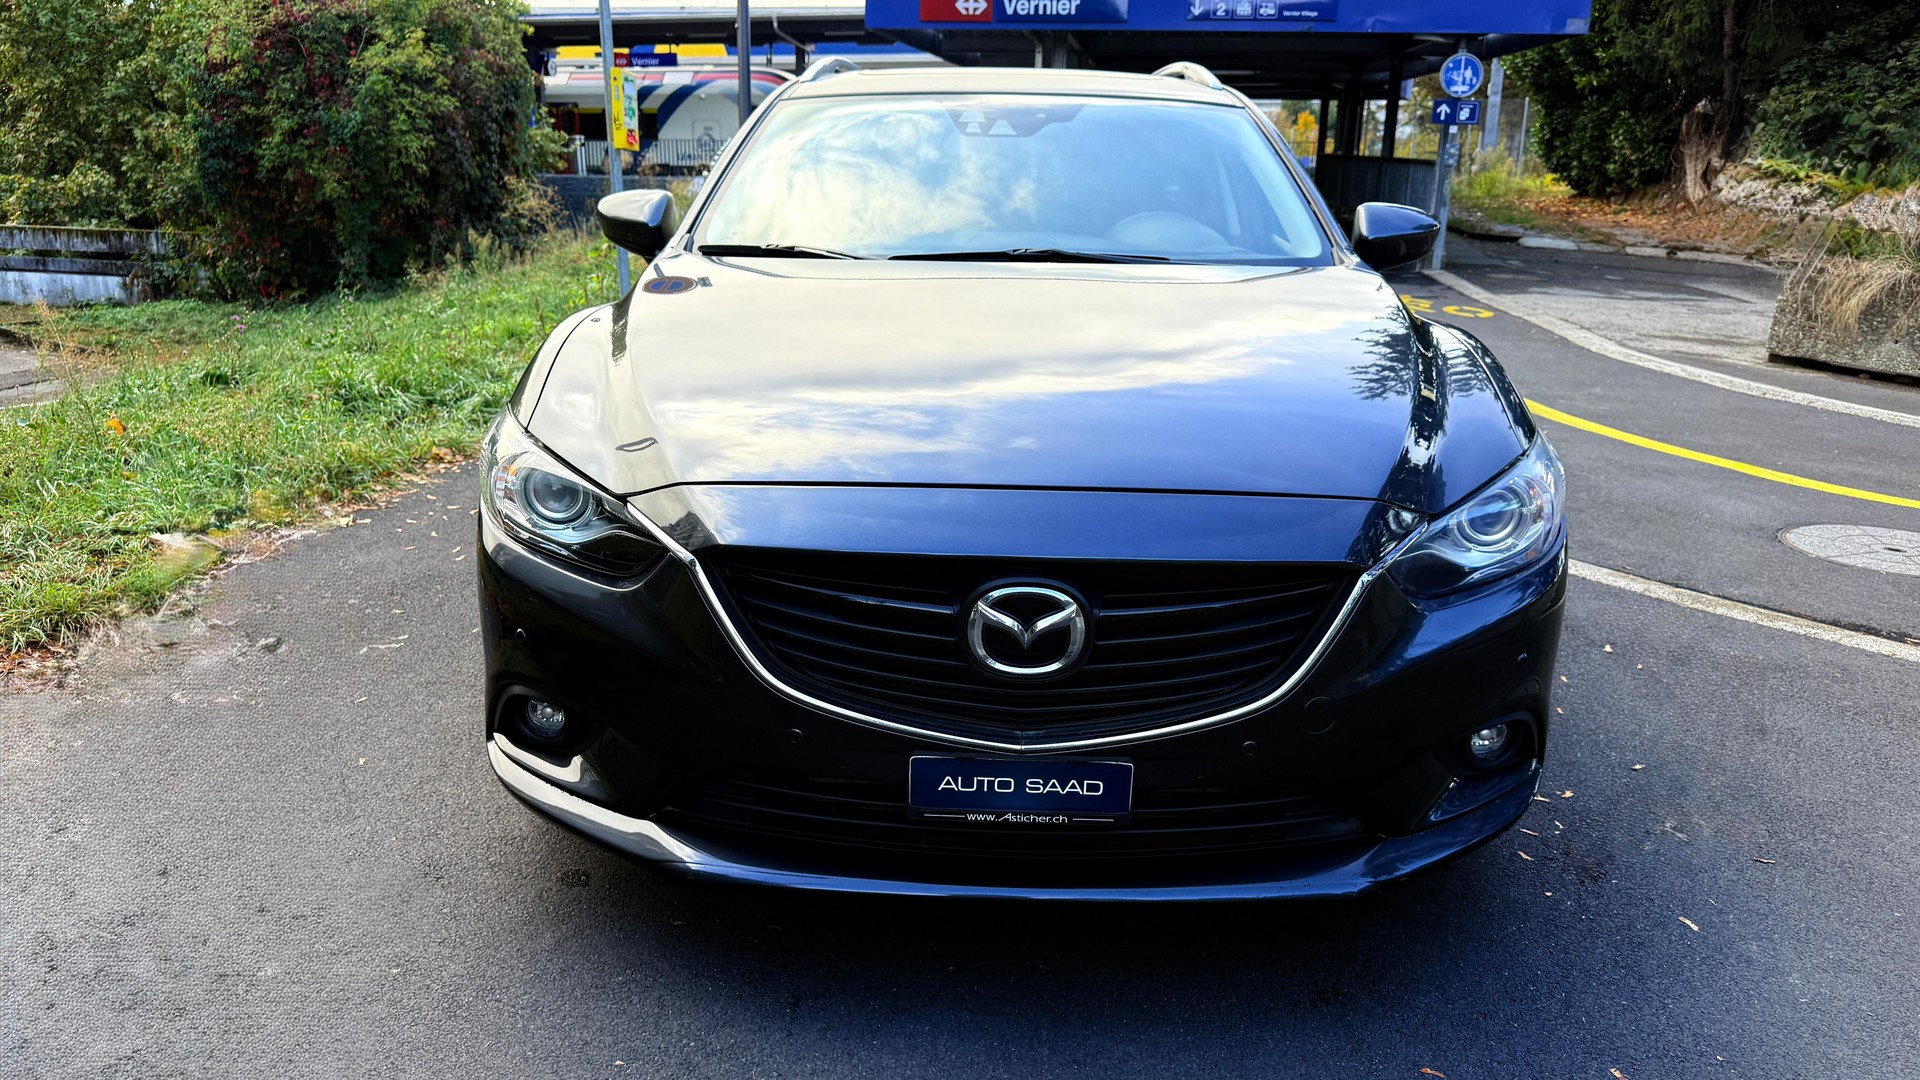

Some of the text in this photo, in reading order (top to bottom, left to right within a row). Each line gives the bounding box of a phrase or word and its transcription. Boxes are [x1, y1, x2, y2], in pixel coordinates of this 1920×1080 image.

[1003, 0, 1080, 15] Vernier
[1216, 3, 1226, 16] 2
[631, 57, 660, 65] Vernier
[938, 776, 1104, 795] AUTO SAAD
[966, 813, 1068, 823] www.Asticher.ch
